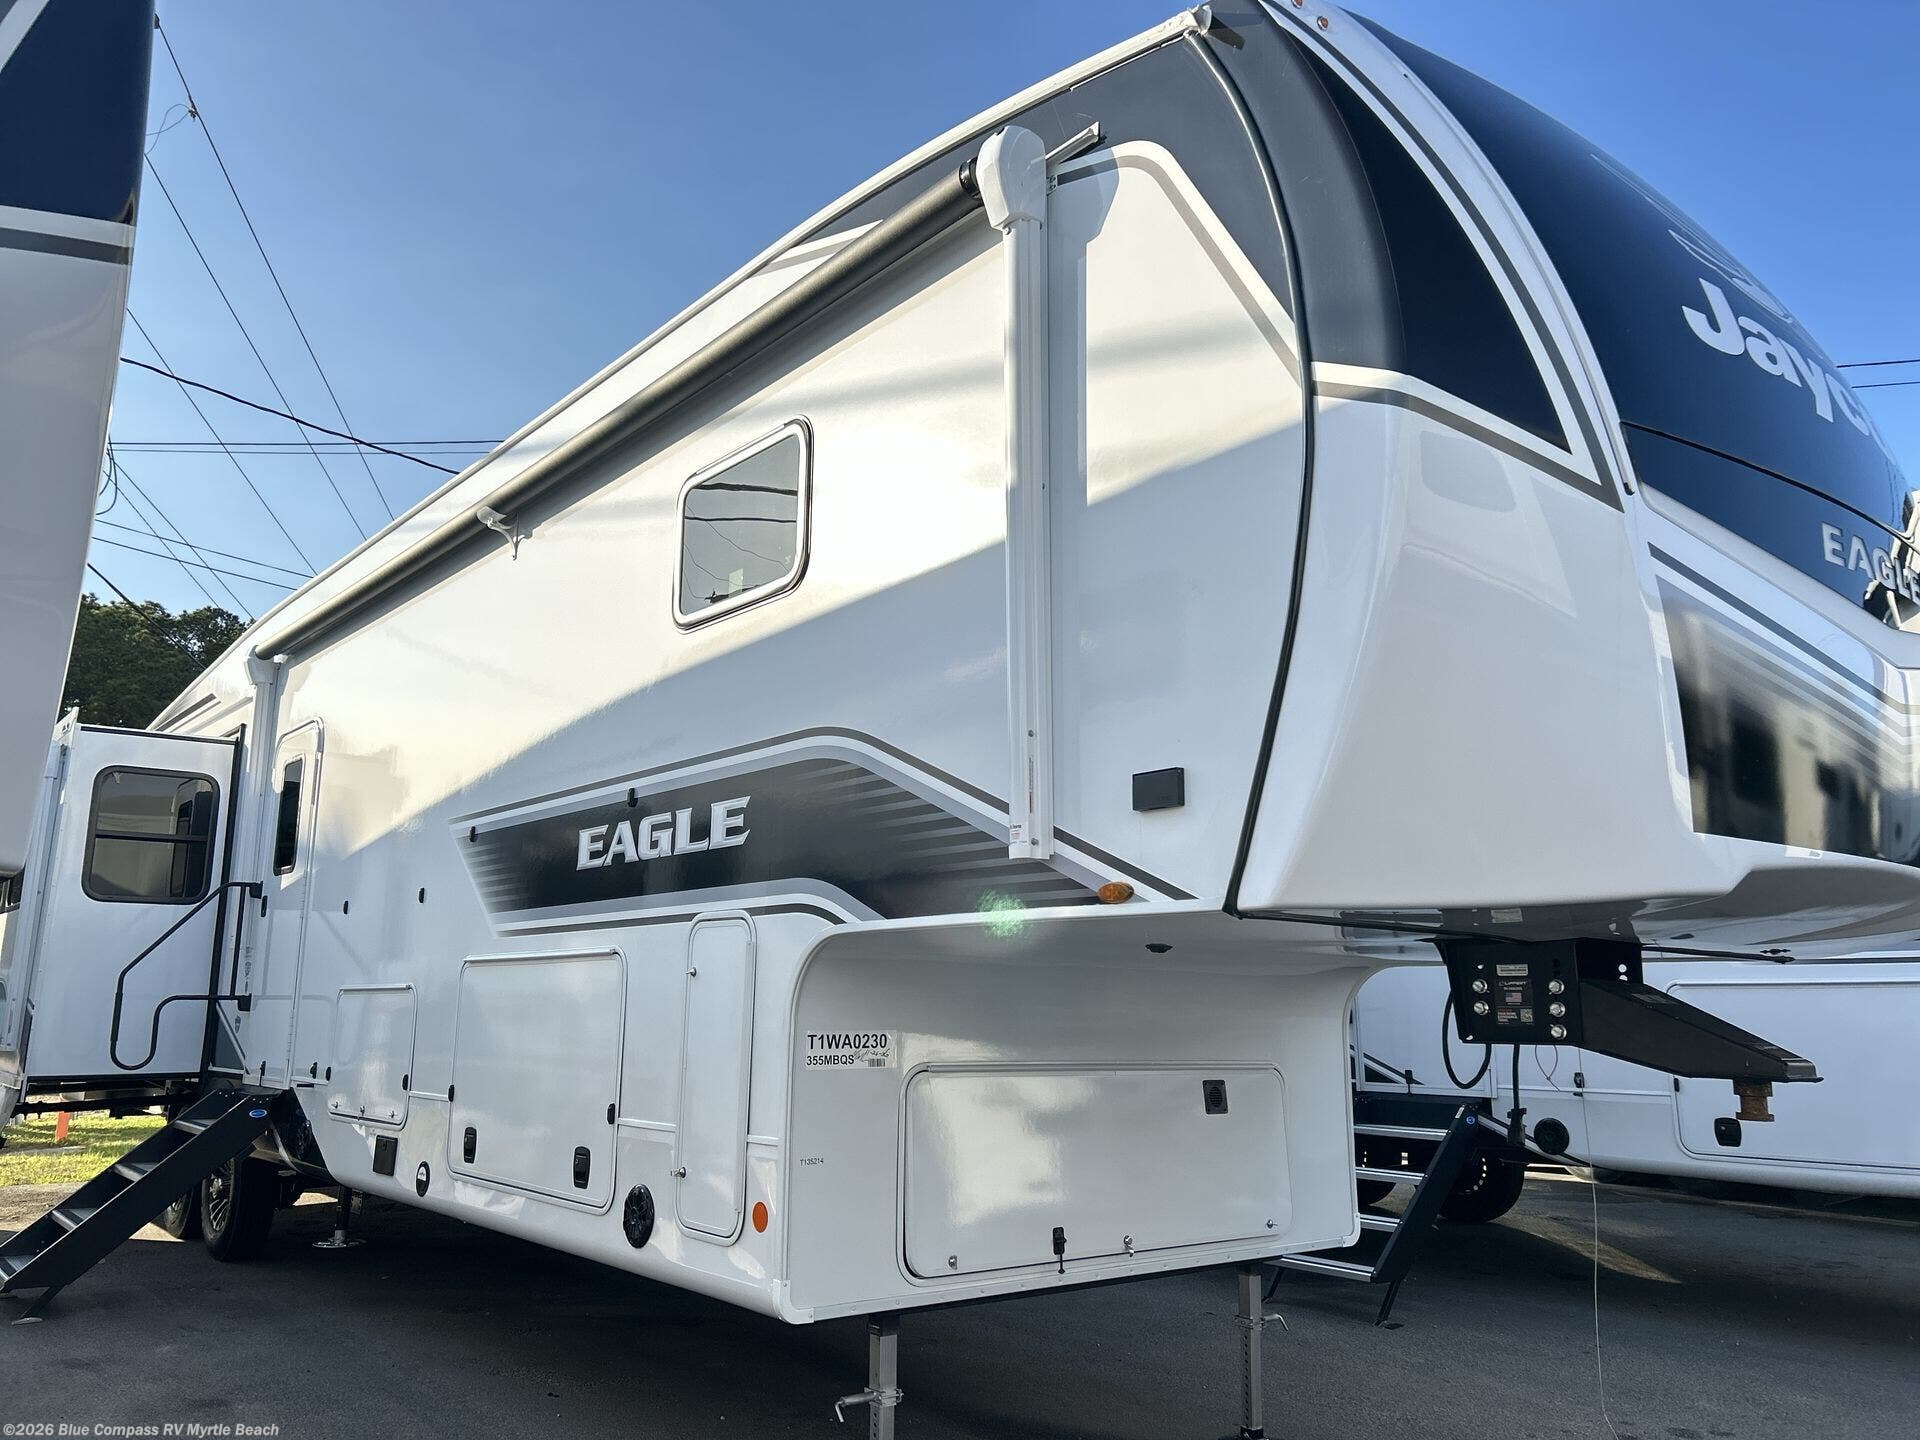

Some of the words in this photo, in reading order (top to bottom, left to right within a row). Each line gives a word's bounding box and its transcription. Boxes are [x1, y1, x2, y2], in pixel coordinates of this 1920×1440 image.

[576, 795, 751, 871] EAGLE
[807, 1033, 888, 1049] T1WA0230
[806, 1054, 855, 1066] 355MBQS
